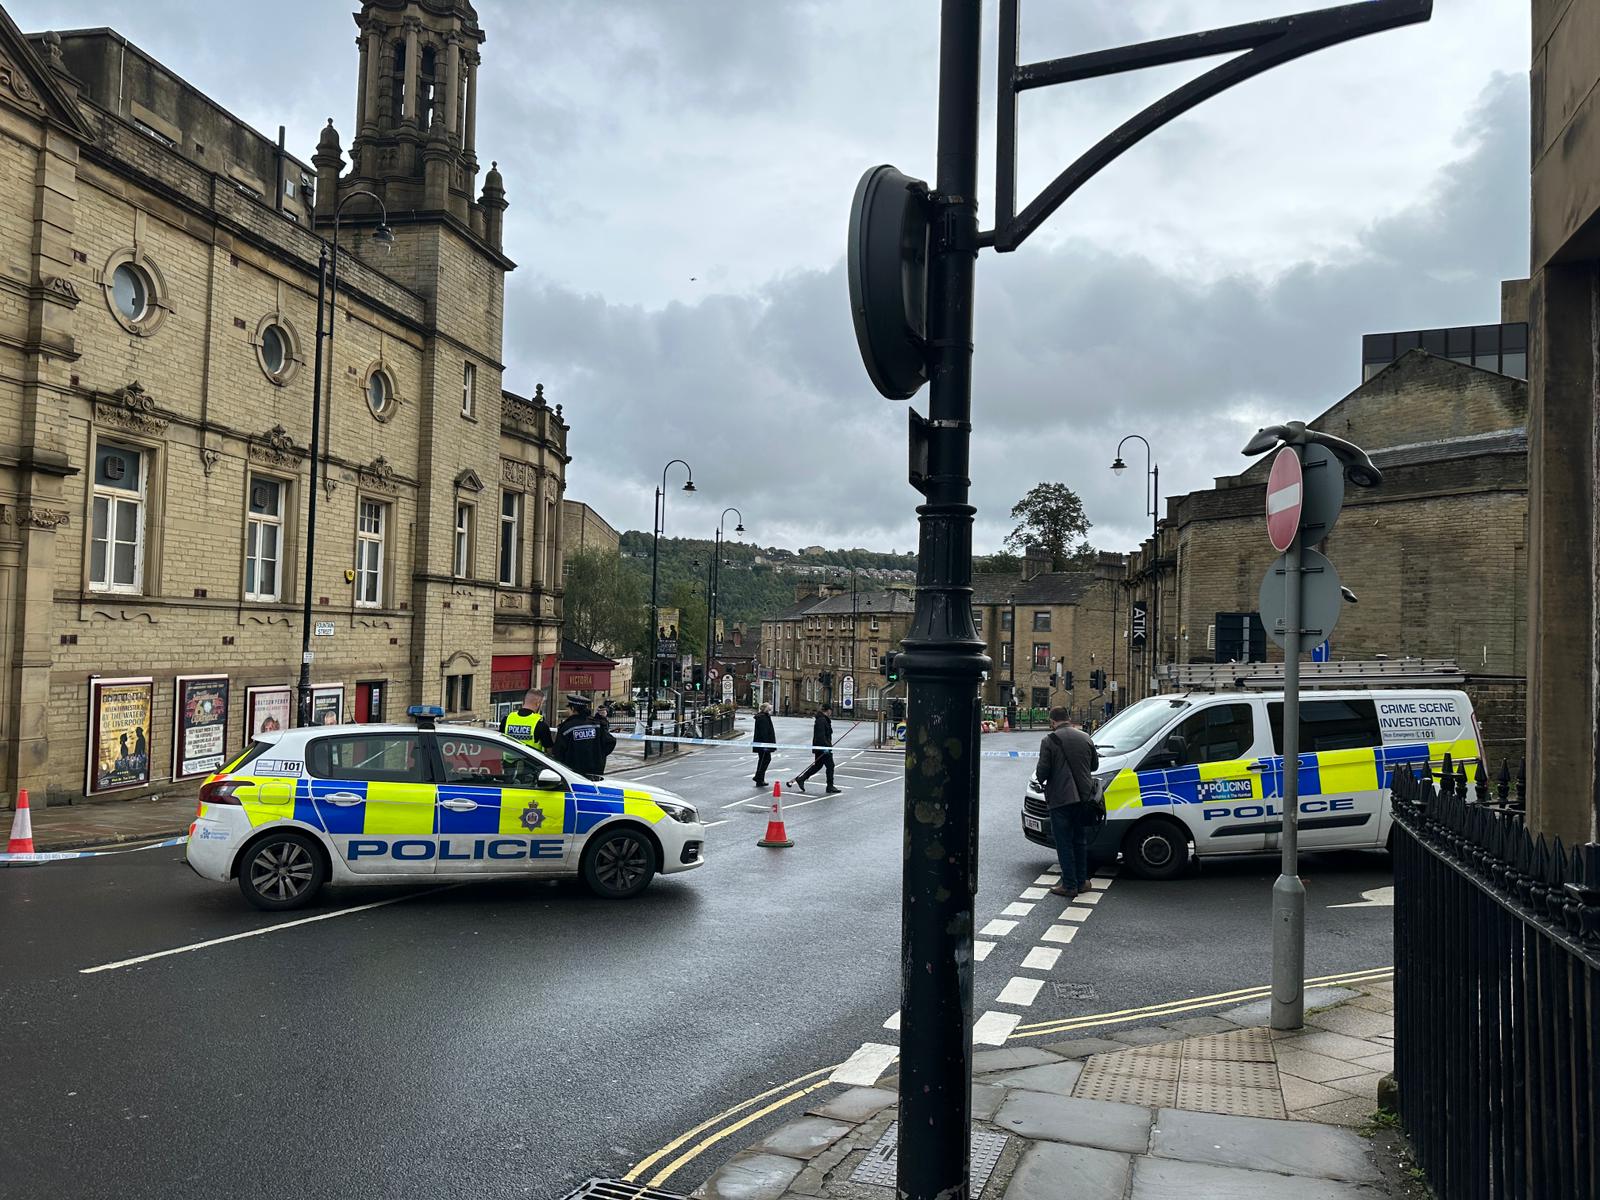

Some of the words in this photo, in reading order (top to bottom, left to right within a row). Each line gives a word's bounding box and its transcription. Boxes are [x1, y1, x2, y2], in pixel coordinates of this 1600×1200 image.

[1133, 607, 1146, 639] ATIK
[569, 674, 593, 685] VICTORIA
[1380, 704, 1417, 714] CRIME
[1419, 703, 1455, 713] SCENE
[112, 719, 144, 728] LIVERPOOL
[1380, 716, 1461, 728] INVESTIGATION
[508, 725, 531, 734] POLICE
[574, 728, 596, 739] POLICE
[442, 742, 482, 756] OAD
[283, 762, 301, 771] 101
[1209, 780, 1252, 793] POLICING
[1203, 798, 1354, 821] POLCE
[347, 839, 565, 861] POLICE
